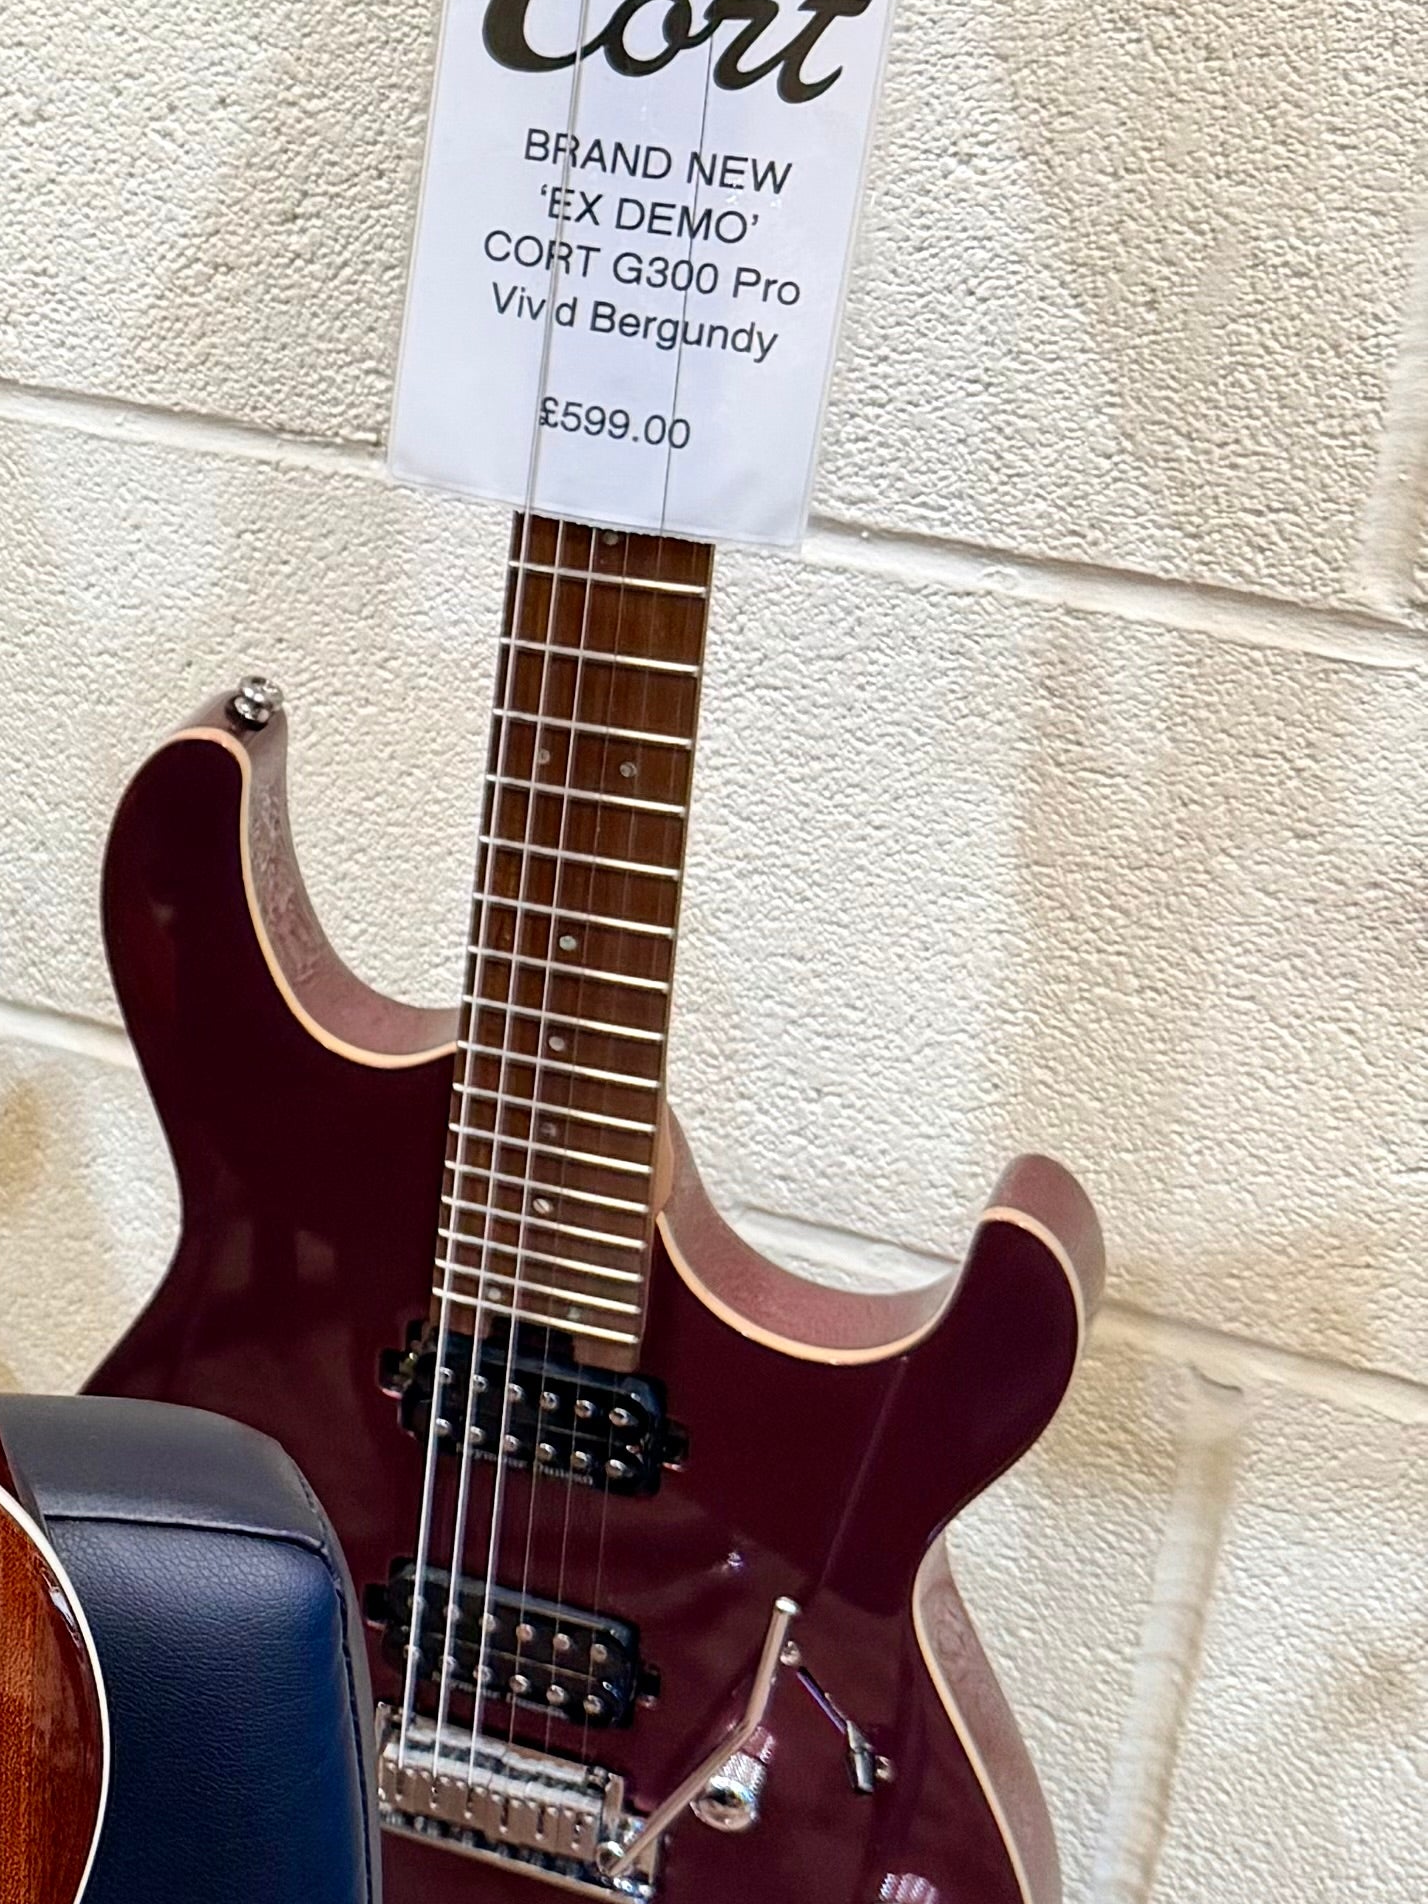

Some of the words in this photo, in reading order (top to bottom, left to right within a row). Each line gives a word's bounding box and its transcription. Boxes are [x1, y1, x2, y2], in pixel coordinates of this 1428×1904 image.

[524, 128, 672, 180] BRAND
[686, 151, 793, 195] NEW
[484, 230, 601, 278] CORT
[612, 251, 719, 295] G300
[732, 267, 801, 306] Pro
[590, 300, 778, 364] Bergundy
[539, 396, 691, 449] £599.00
